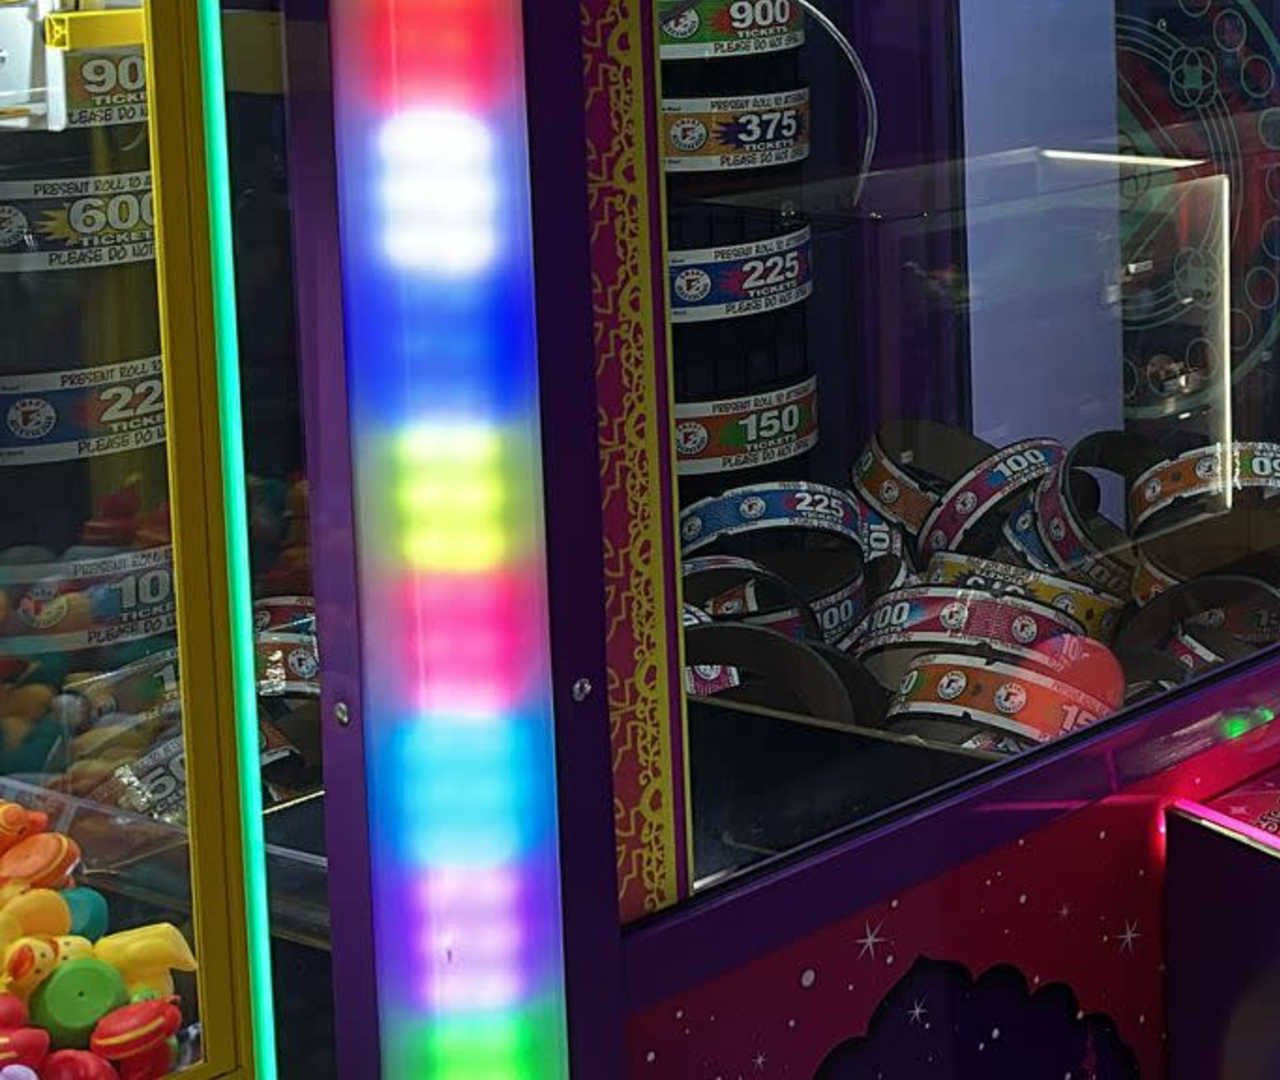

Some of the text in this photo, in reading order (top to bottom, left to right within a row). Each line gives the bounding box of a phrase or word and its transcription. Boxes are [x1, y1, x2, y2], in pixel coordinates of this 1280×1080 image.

[82, 56, 146, 94] 90
[738, 110, 797, 142] 375
[33, 178, 90, 196] PRESENT
[49, 250, 103, 266] PLEASE
[741, 251, 799, 290] 225
[60, 370, 115, 387] PRESENT
[100, 379, 165, 422] 22
[738, 404, 800, 442] 150
[78, 434, 130, 455] PLEASE
[993, 449, 1046, 478] 100
[794, 491, 845, 519] 225
[114, 570, 172, 611] 10
